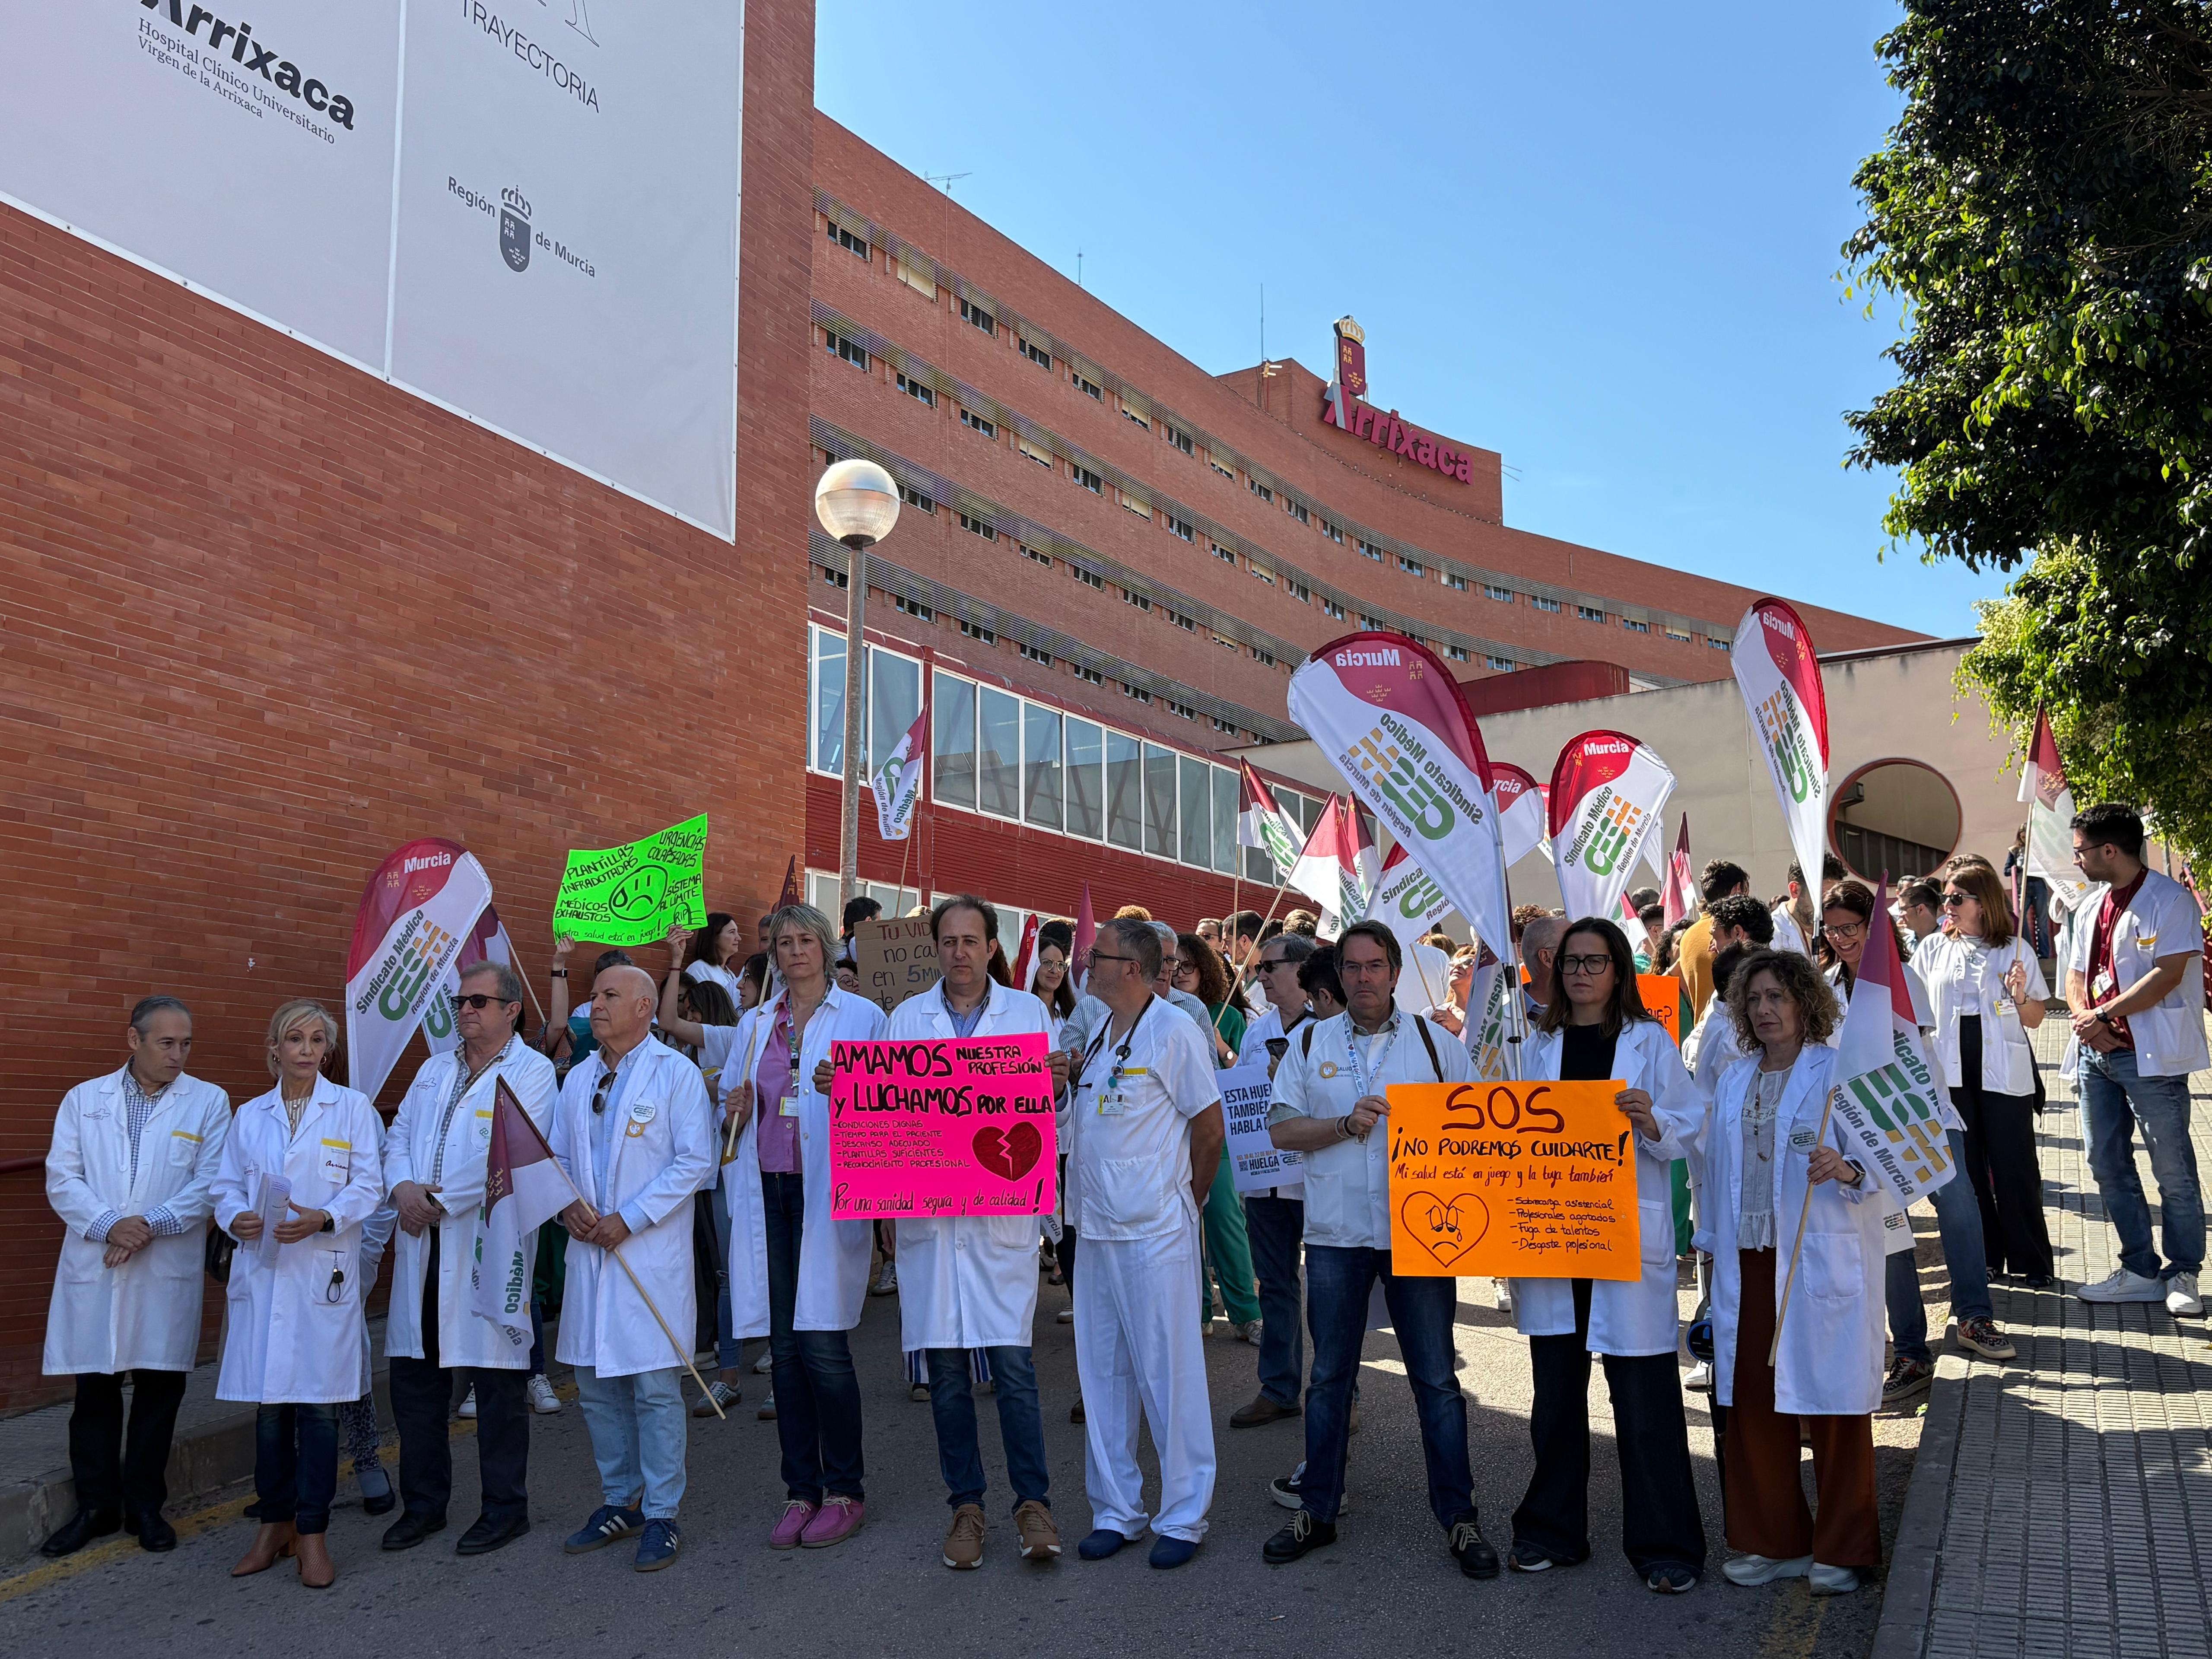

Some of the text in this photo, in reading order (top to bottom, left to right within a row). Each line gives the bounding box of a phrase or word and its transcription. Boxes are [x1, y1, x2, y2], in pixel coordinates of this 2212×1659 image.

[464, 0, 599, 113] TRAYECTORIA
[138, 35, 263, 119] Virgen de la Arrixaca
[138, 17, 335, 145] Hospital Clínico Universitario
[448, 175, 595, 278] Región de Murcia
[1323, 380, 1473, 485] Arrixaca
[1584, 741, 1629, 756] Murcia
[1564, 785, 1613, 868] Sindicato Médico
[1616, 813, 1651, 874] Región de Murcia
[404, 851, 451, 874] Murcia
[1338, 866, 1366, 910] Sindicato
[1382, 867, 1424, 905] Sindica
[555, 911, 611, 923] EXHAUSTOS
[659, 899, 667, 912] AL
[675, 909, 688, 922] RIP
[1426, 898, 1450, 921] Regió
[584, 929, 605, 940] salud
[608, 931, 625, 942] está
[905, 922, 931, 938] VID
[356, 909, 425, 1016] Sindicato Médico
[430, 967, 439, 983] de
[436, 937, 460, 972] Murcia
[883, 947, 907, 963] no
[873, 970, 895, 987] en
[907, 964, 921, 982] 5
[834, 1042, 1022, 1077] AMAMOS NUESTRA
[967, 1056, 1043, 1075] PROFESIÓN
[1893, 1029, 1931, 1085] dicato
[853, 1081, 973, 1118] LUCHAMOS
[977, 1094, 1007, 1115] POR
[1014, 1095, 1053, 1114] ELLA
[1224, 1088, 1249, 1104] ESTA
[1441, 1084, 1565, 1134] SOS
[892, 1119, 924, 1128] DIGNAS
[906, 1130, 943, 1138] PACIENTE
[1230, 1118, 1263, 1136] HABLA
[889, 1139, 931, 1147] ADECUADO
[1438, 1138, 1522, 1160] PODREMOS
[1531, 1130, 1630, 1166] CUIDARTE!
[1833, 1084, 1865, 1129] Región
[1859, 1130, 1879, 1148] de
[1874, 1147, 1915, 1196] Murcia
[892, 1147, 944, 1158] SUFICIENTES
[909, 1158, 971, 1167] PROFESIONAL
[1249, 1155, 1280, 1170] HUELGA
[1395, 1163, 1614, 1189] Mi salud está en juego y la tuya también
[833, 1182, 853, 1212] Por
[854, 1197, 872, 1211] una
[875, 1190, 914, 1211] sanidad
[922, 1193, 953, 1216] segura
[961, 1196, 967, 1216] y
[973, 1189, 984, 1206] de
[989, 1189, 1028, 1207] calidad
[1565, 1198, 1615, 1210] asistencial
[1545, 1223, 1558, 1233] de
[1560, 1224, 1600, 1236] talentos
[1569, 1212, 1616, 1225] agotados
[1566, 1238, 1612, 1254] profesional
